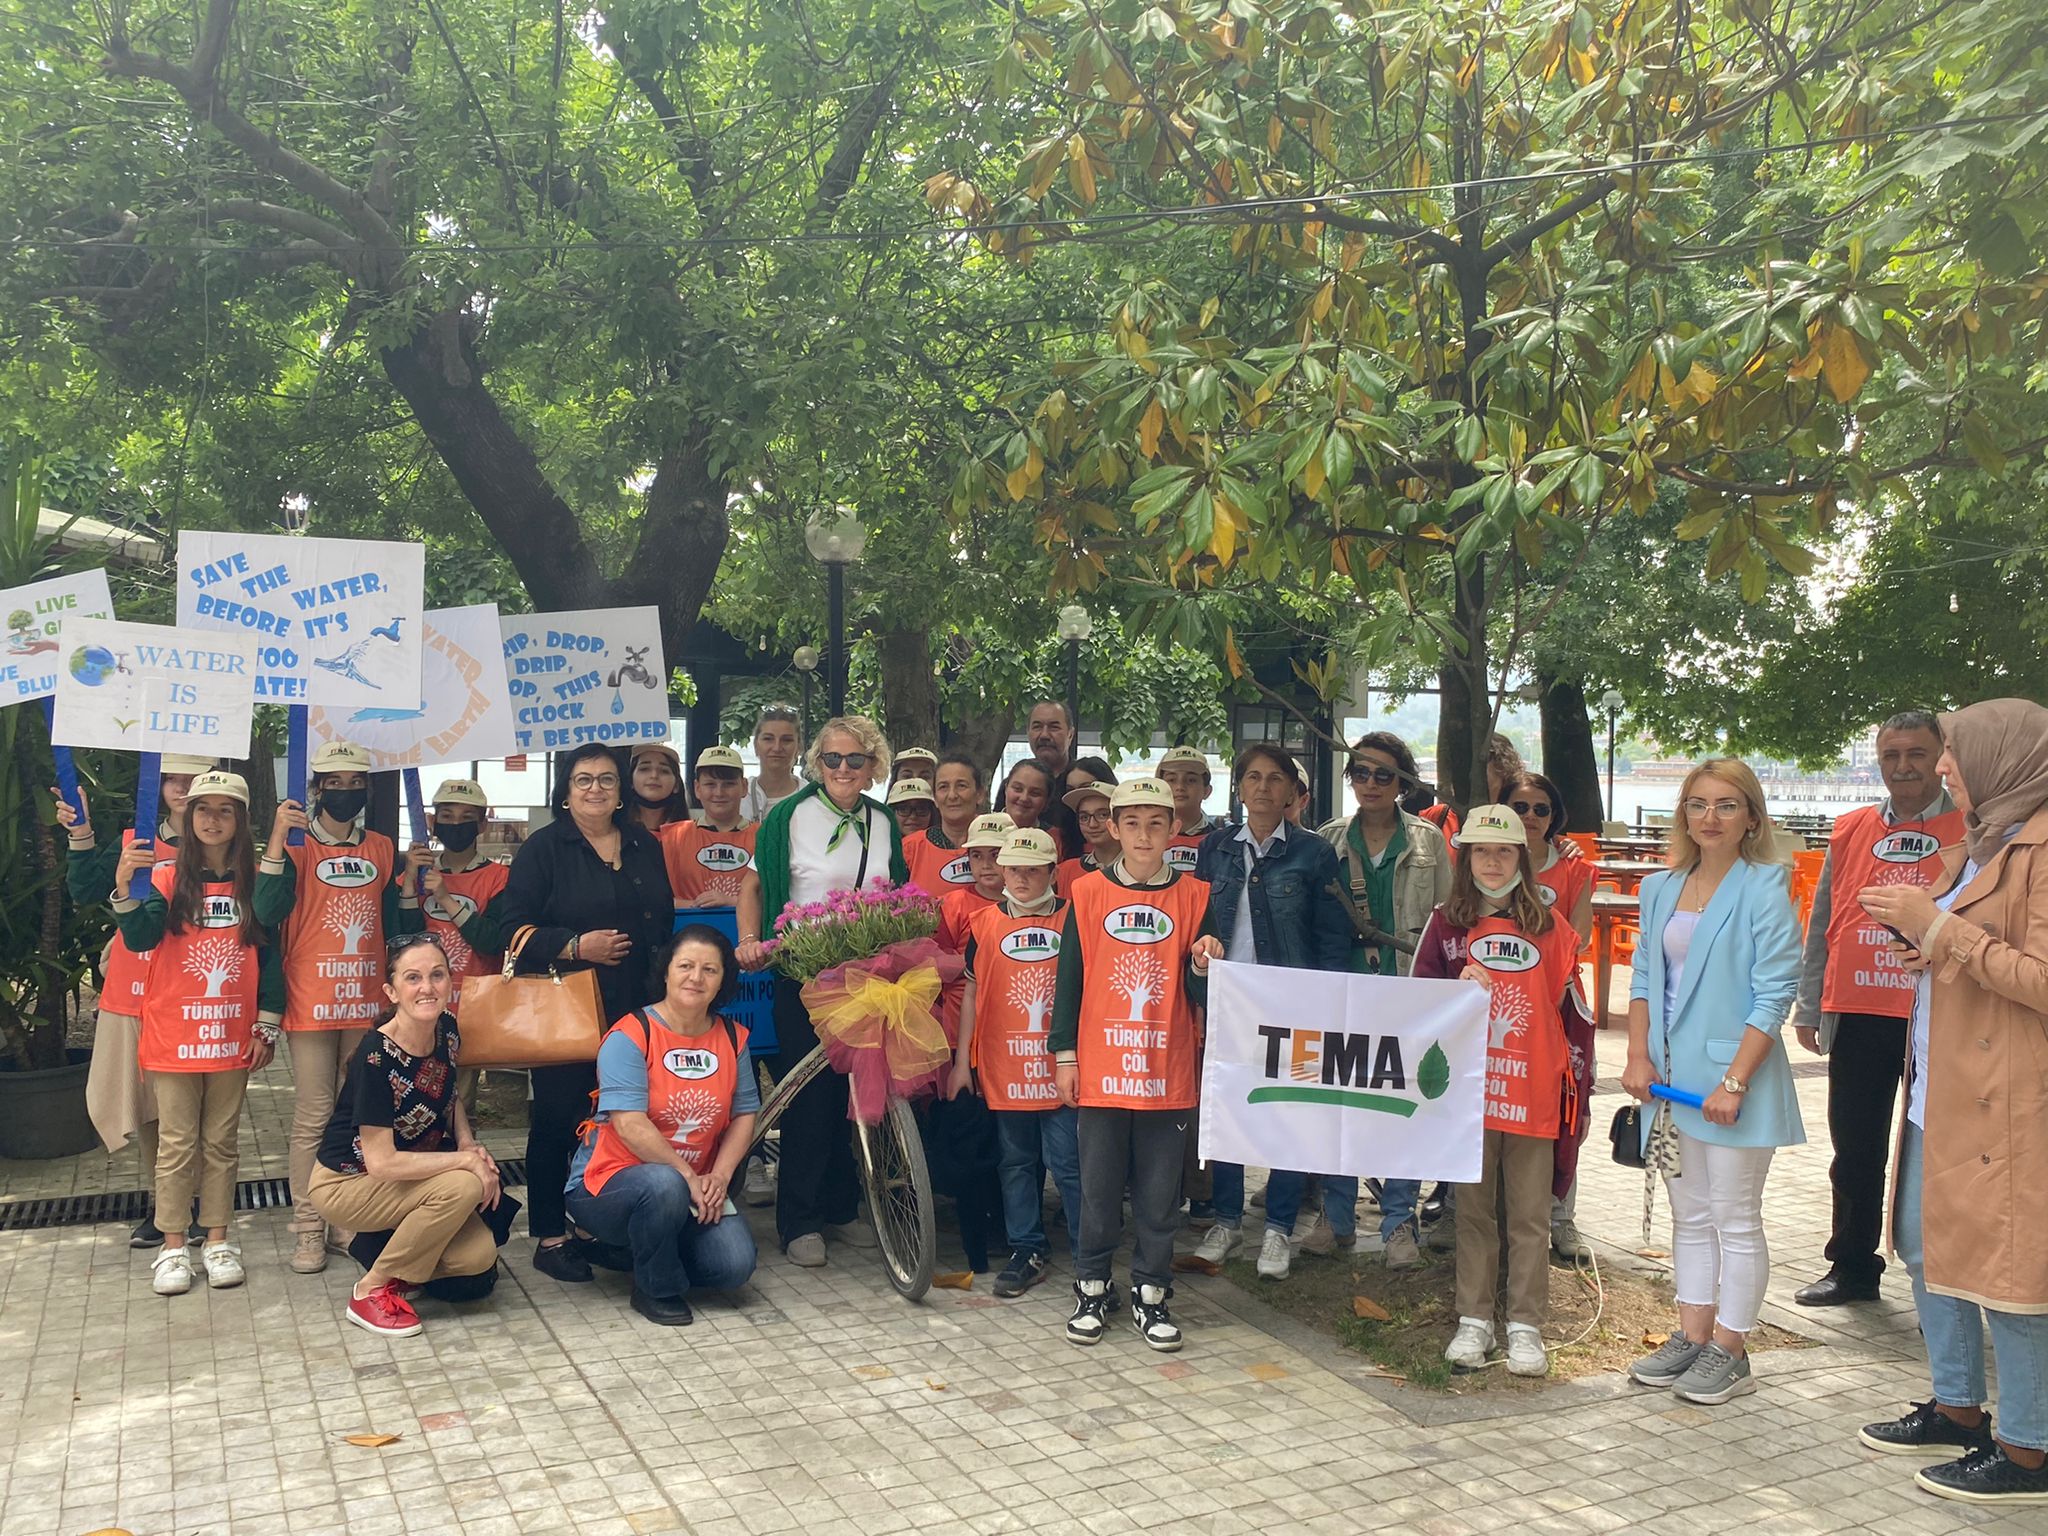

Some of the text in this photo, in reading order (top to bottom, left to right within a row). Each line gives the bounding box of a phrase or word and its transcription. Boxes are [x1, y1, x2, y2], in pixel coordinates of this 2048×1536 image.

[190, 551, 389, 611] SAVE THE WATER,
[35, 593, 77, 615] LIVE
[195, 593, 349, 640] BEFORE IT'S
[546, 630, 609, 658] DROP,
[134, 645, 246, 675] WATER
[514, 654, 573, 675] DRIP,
[168, 682, 197, 705] IS
[553, 670, 602, 701] THIS
[150, 711, 221, 736] LIFE
[518, 702, 585, 725] CLOCK
[372, 741, 424, 768] THE
[424, 686, 491, 757] EARTH
[543, 728, 570, 747] BE
[573, 720, 667, 744] STOPPED
[707, 849, 735, 860] TEMA
[1887, 838, 1923, 851] TEMA
[1171, 850, 1196, 862] TEMA
[328, 861, 363, 874] TEMA
[1119, 912, 1154, 928] TEMA
[1013, 933, 1047, 947] TEMA
[1485, 941, 1520, 958] TEMA
[316, 957, 377, 978] TÜRKİYE
[335, 979, 364, 1001] ÇÖL
[181, 1001, 242, 1020] TÜRKİYE
[313, 1002, 380, 1021] OLMASIN
[198, 1021, 226, 1042] ÇÖL
[1103, 1024, 1167, 1049] TÜRKİYE
[673, 1054, 703, 1068] TEMA
[1121, 1050, 1150, 1077] ÇÖL
[1258, 1024, 1406, 1090] TEMA
[1024, 1057, 1051, 1083] ÇÖL
[1007, 1082, 1057, 1100] OLMAS
[1102, 1076, 1167, 1098] OLMASIN
